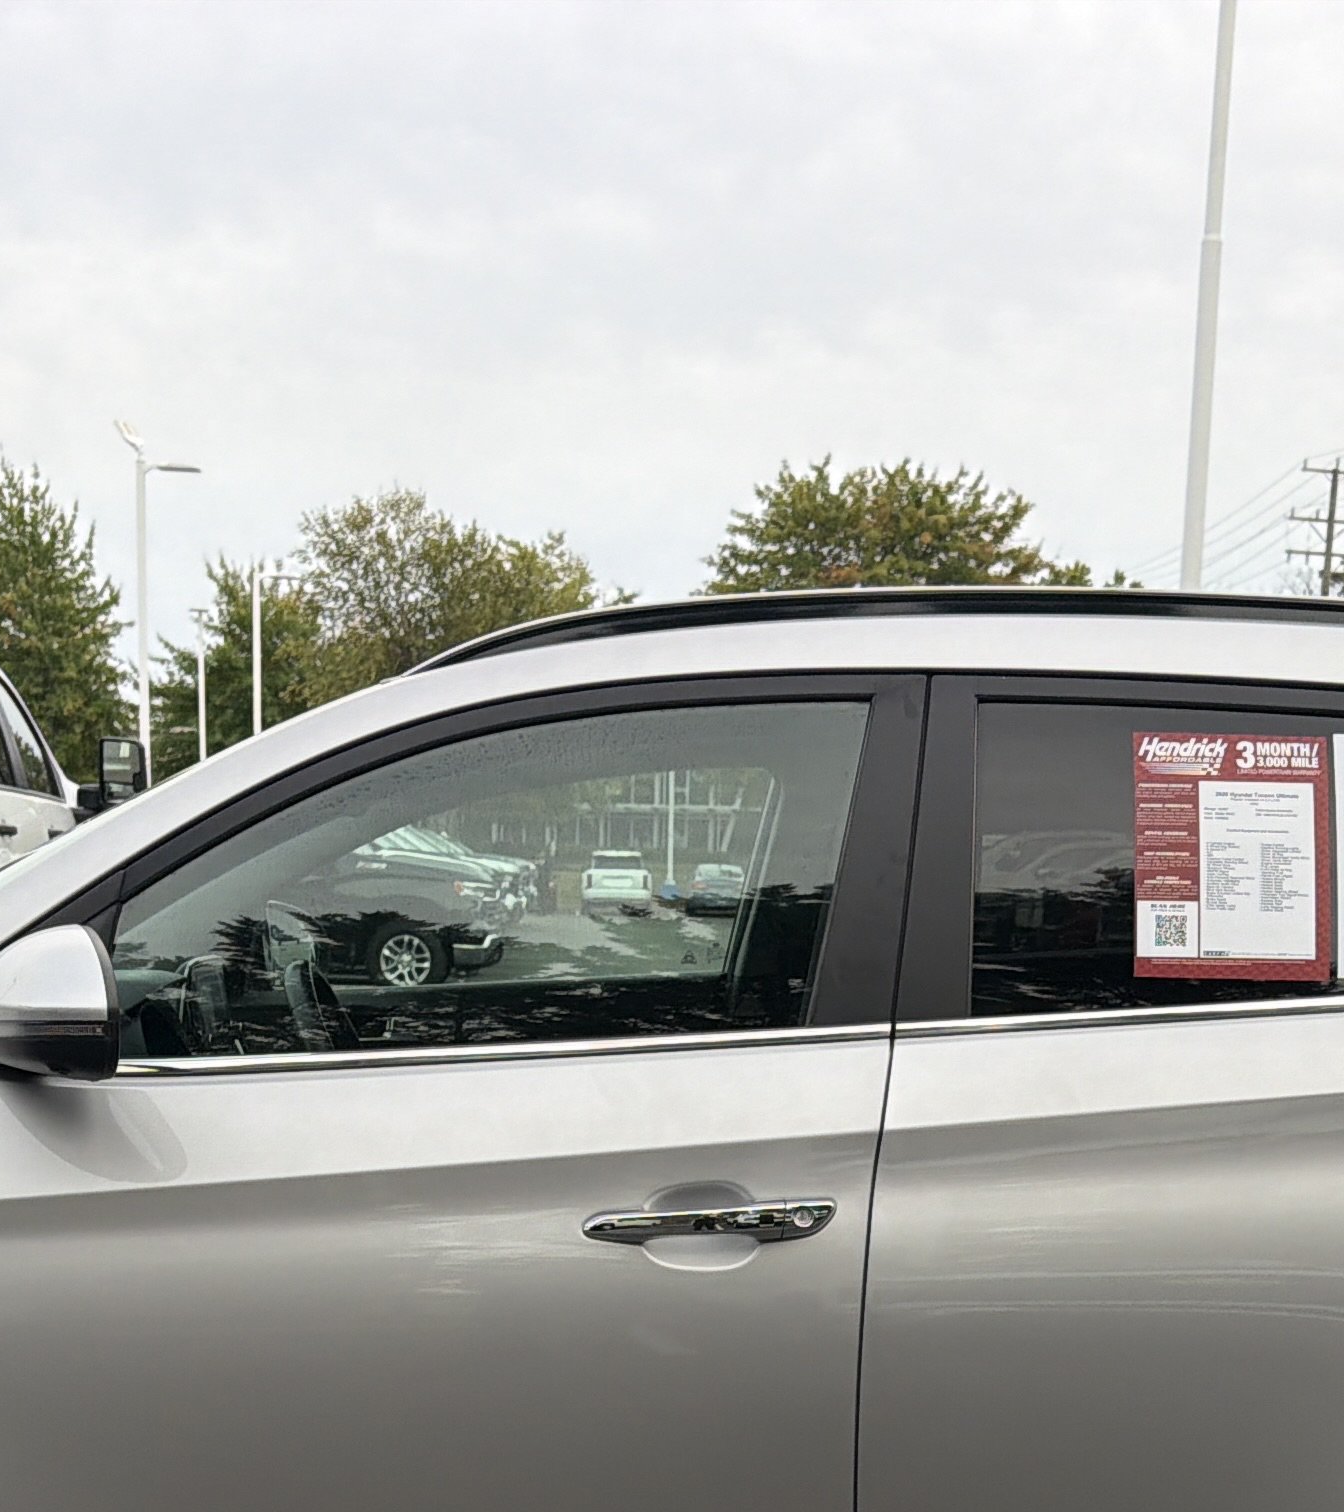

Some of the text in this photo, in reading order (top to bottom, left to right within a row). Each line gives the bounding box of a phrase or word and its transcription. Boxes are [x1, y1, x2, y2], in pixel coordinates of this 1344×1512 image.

[1138, 736, 1229, 762] Hendrick
[1235, 740, 1319, 769] 3 MONTH/
[1256, 757, 1319, 769] 3,000 MILE
